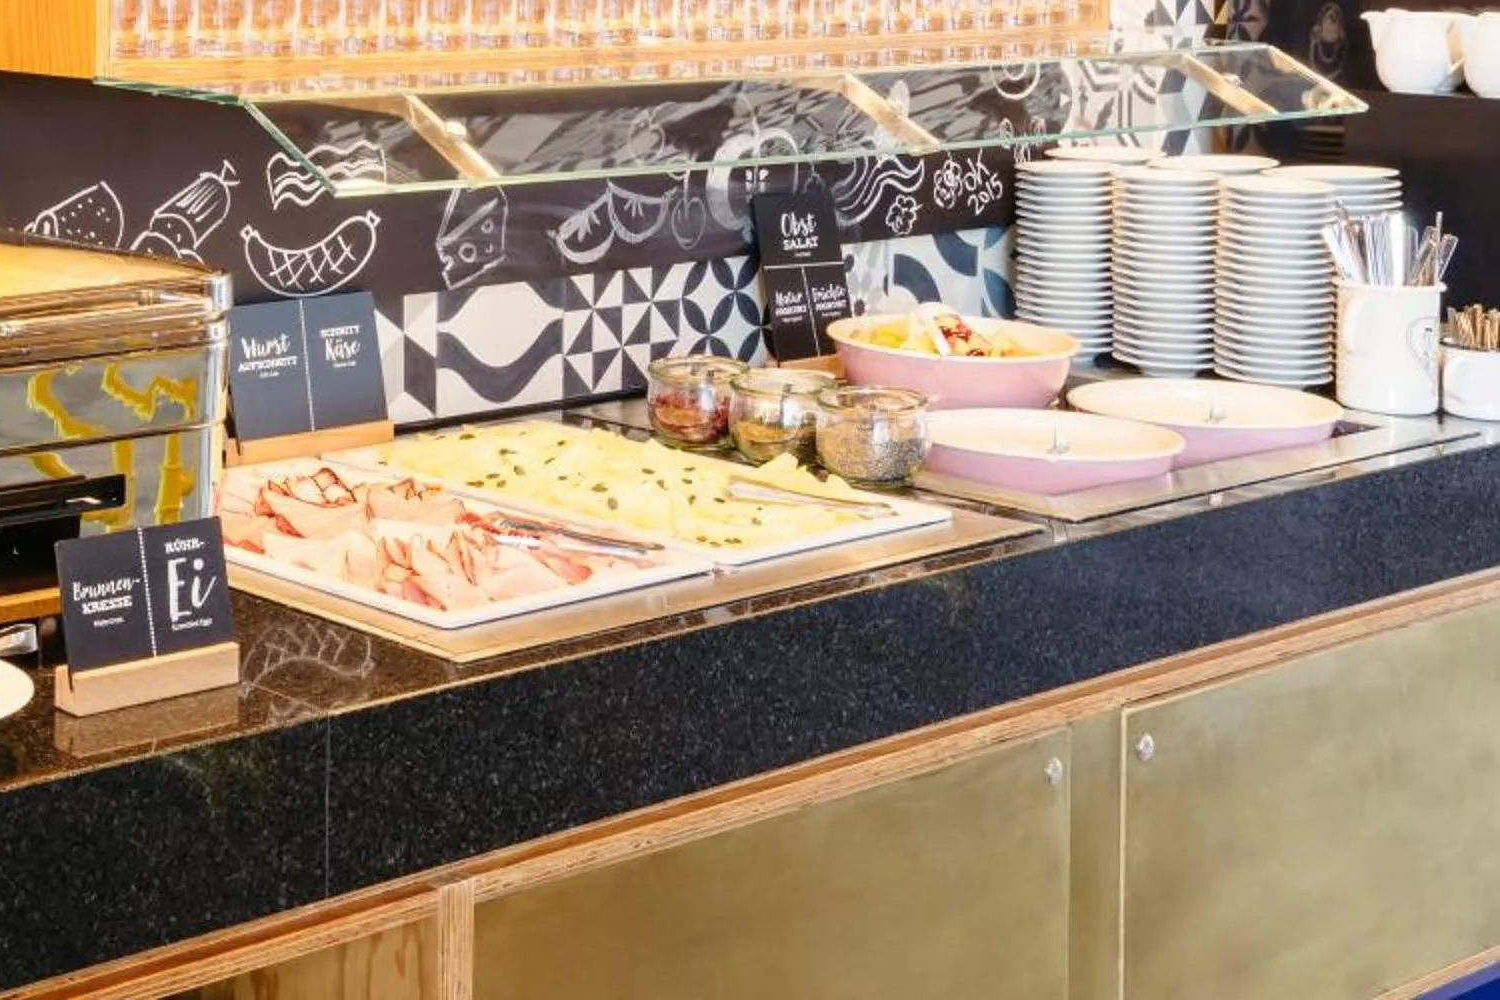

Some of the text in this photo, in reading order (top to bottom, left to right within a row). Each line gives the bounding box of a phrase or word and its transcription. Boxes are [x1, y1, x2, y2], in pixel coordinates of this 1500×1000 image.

[967, 172, 1003, 216] 2015
[781, 211, 817, 237] Obst
[783, 235, 819, 250] SALAT
[241, 332, 291, 360] Wurst
[325, 338, 361, 361] Käse
[168, 558, 217, 622] Ei
[82, 595, 133, 615] KRESSE
